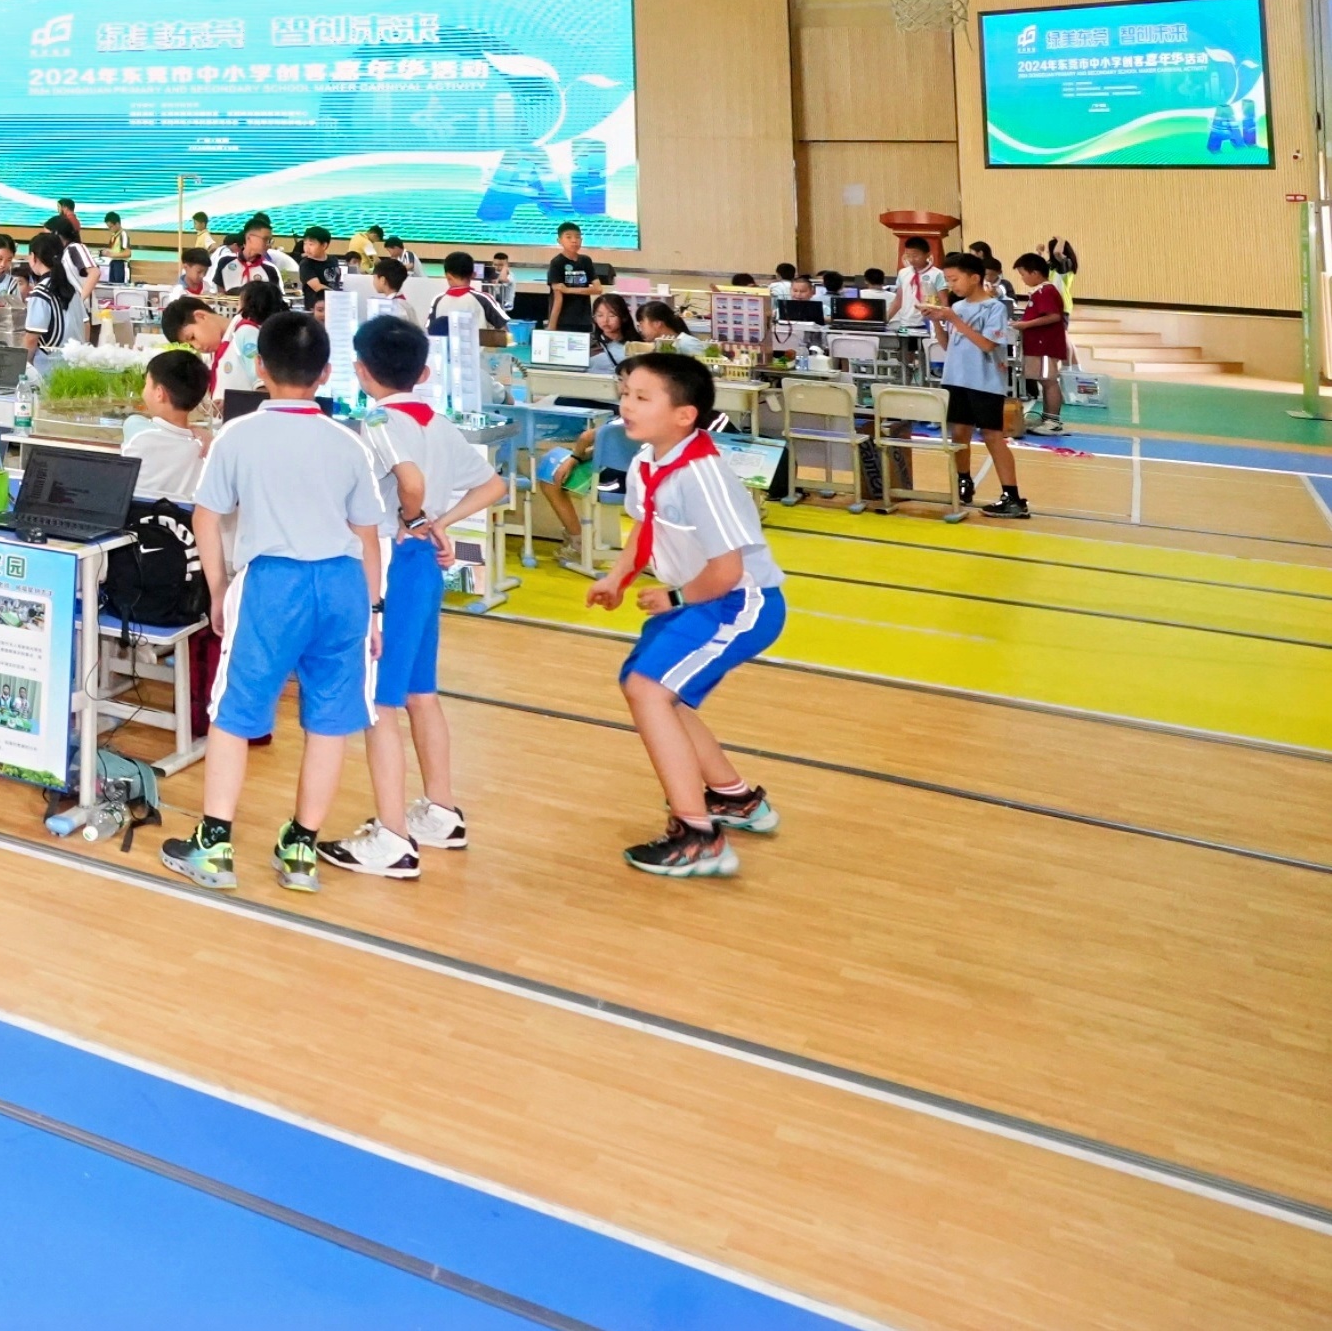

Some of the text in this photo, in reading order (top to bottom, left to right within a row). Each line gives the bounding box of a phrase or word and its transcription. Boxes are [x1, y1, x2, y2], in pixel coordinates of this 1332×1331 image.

[96, 13, 440, 53] 绿美东莞 智创未来
[1046, 23, 1188, 50] 绿美东莞 智创未来
[263, 83, 308, 92] SCHOOL
[1206, 99, 1257, 155] AI
[476, 137, 608, 223] AI
